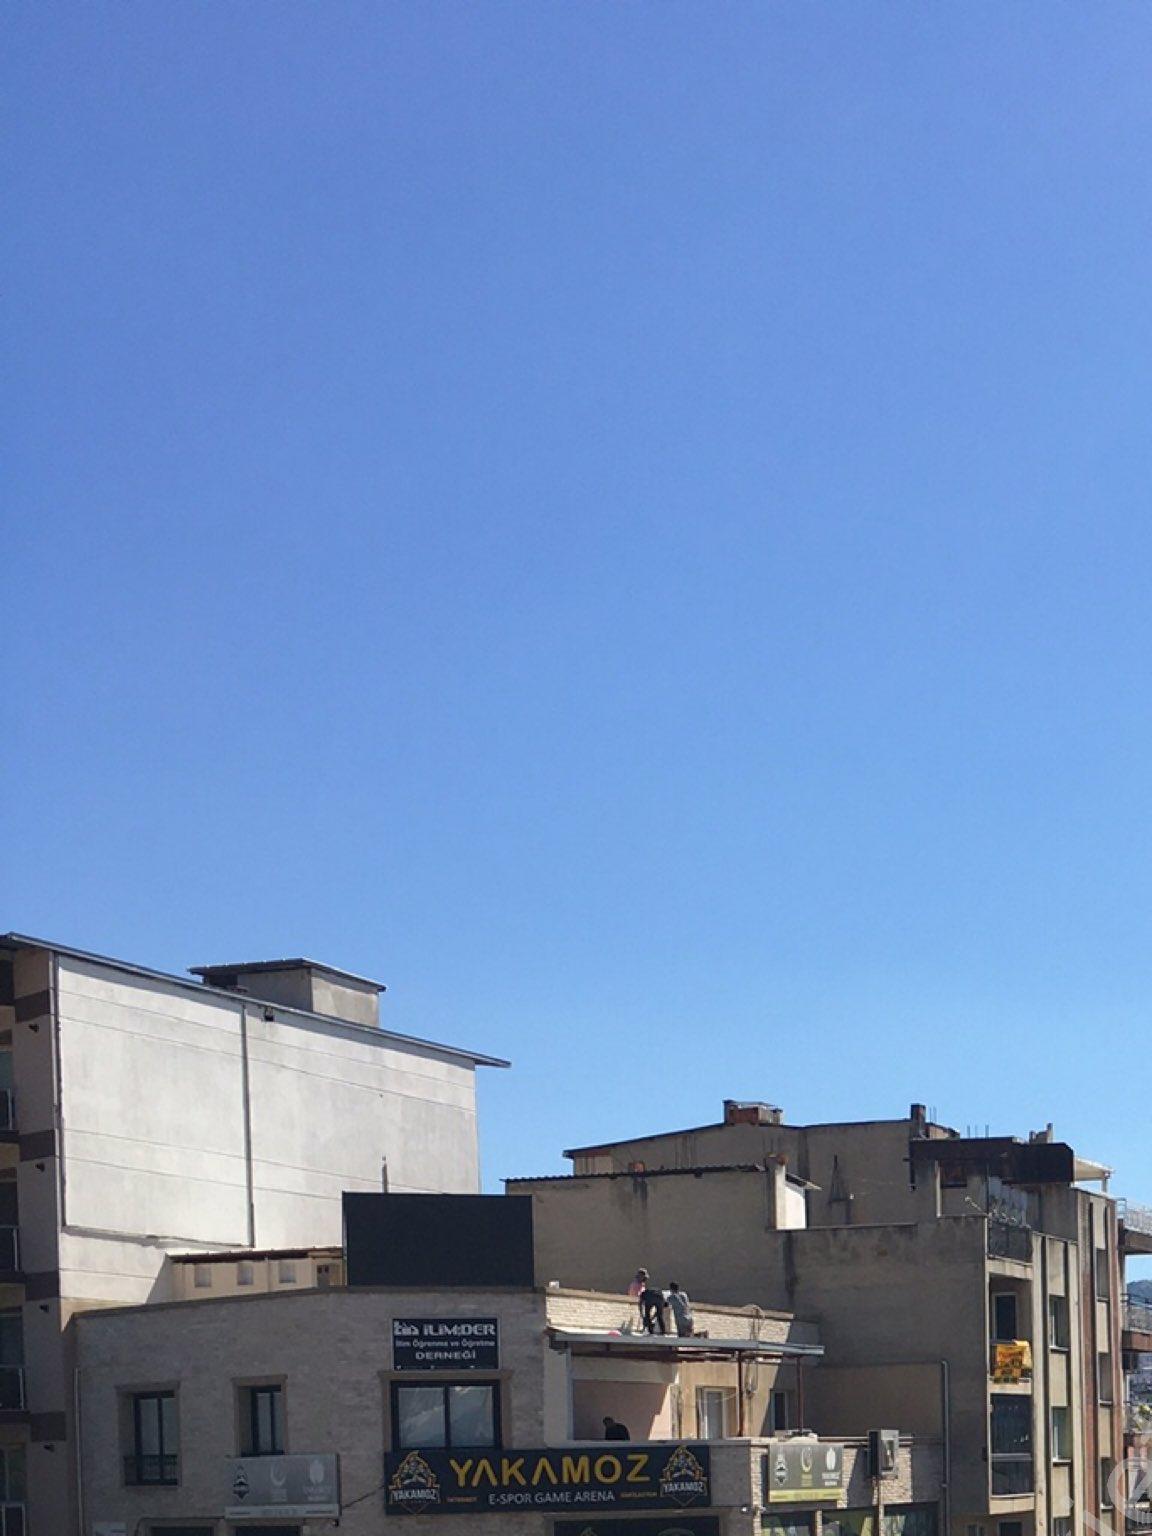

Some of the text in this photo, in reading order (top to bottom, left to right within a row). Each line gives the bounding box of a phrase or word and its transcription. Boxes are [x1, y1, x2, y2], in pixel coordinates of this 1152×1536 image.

[449, 1453, 651, 1488] YAKAMOZ
[487, 1492, 533, 1506] E-SPOR
[534, 1491, 572, 1504] GAME
[574, 1490, 616, 1503] ARENA
